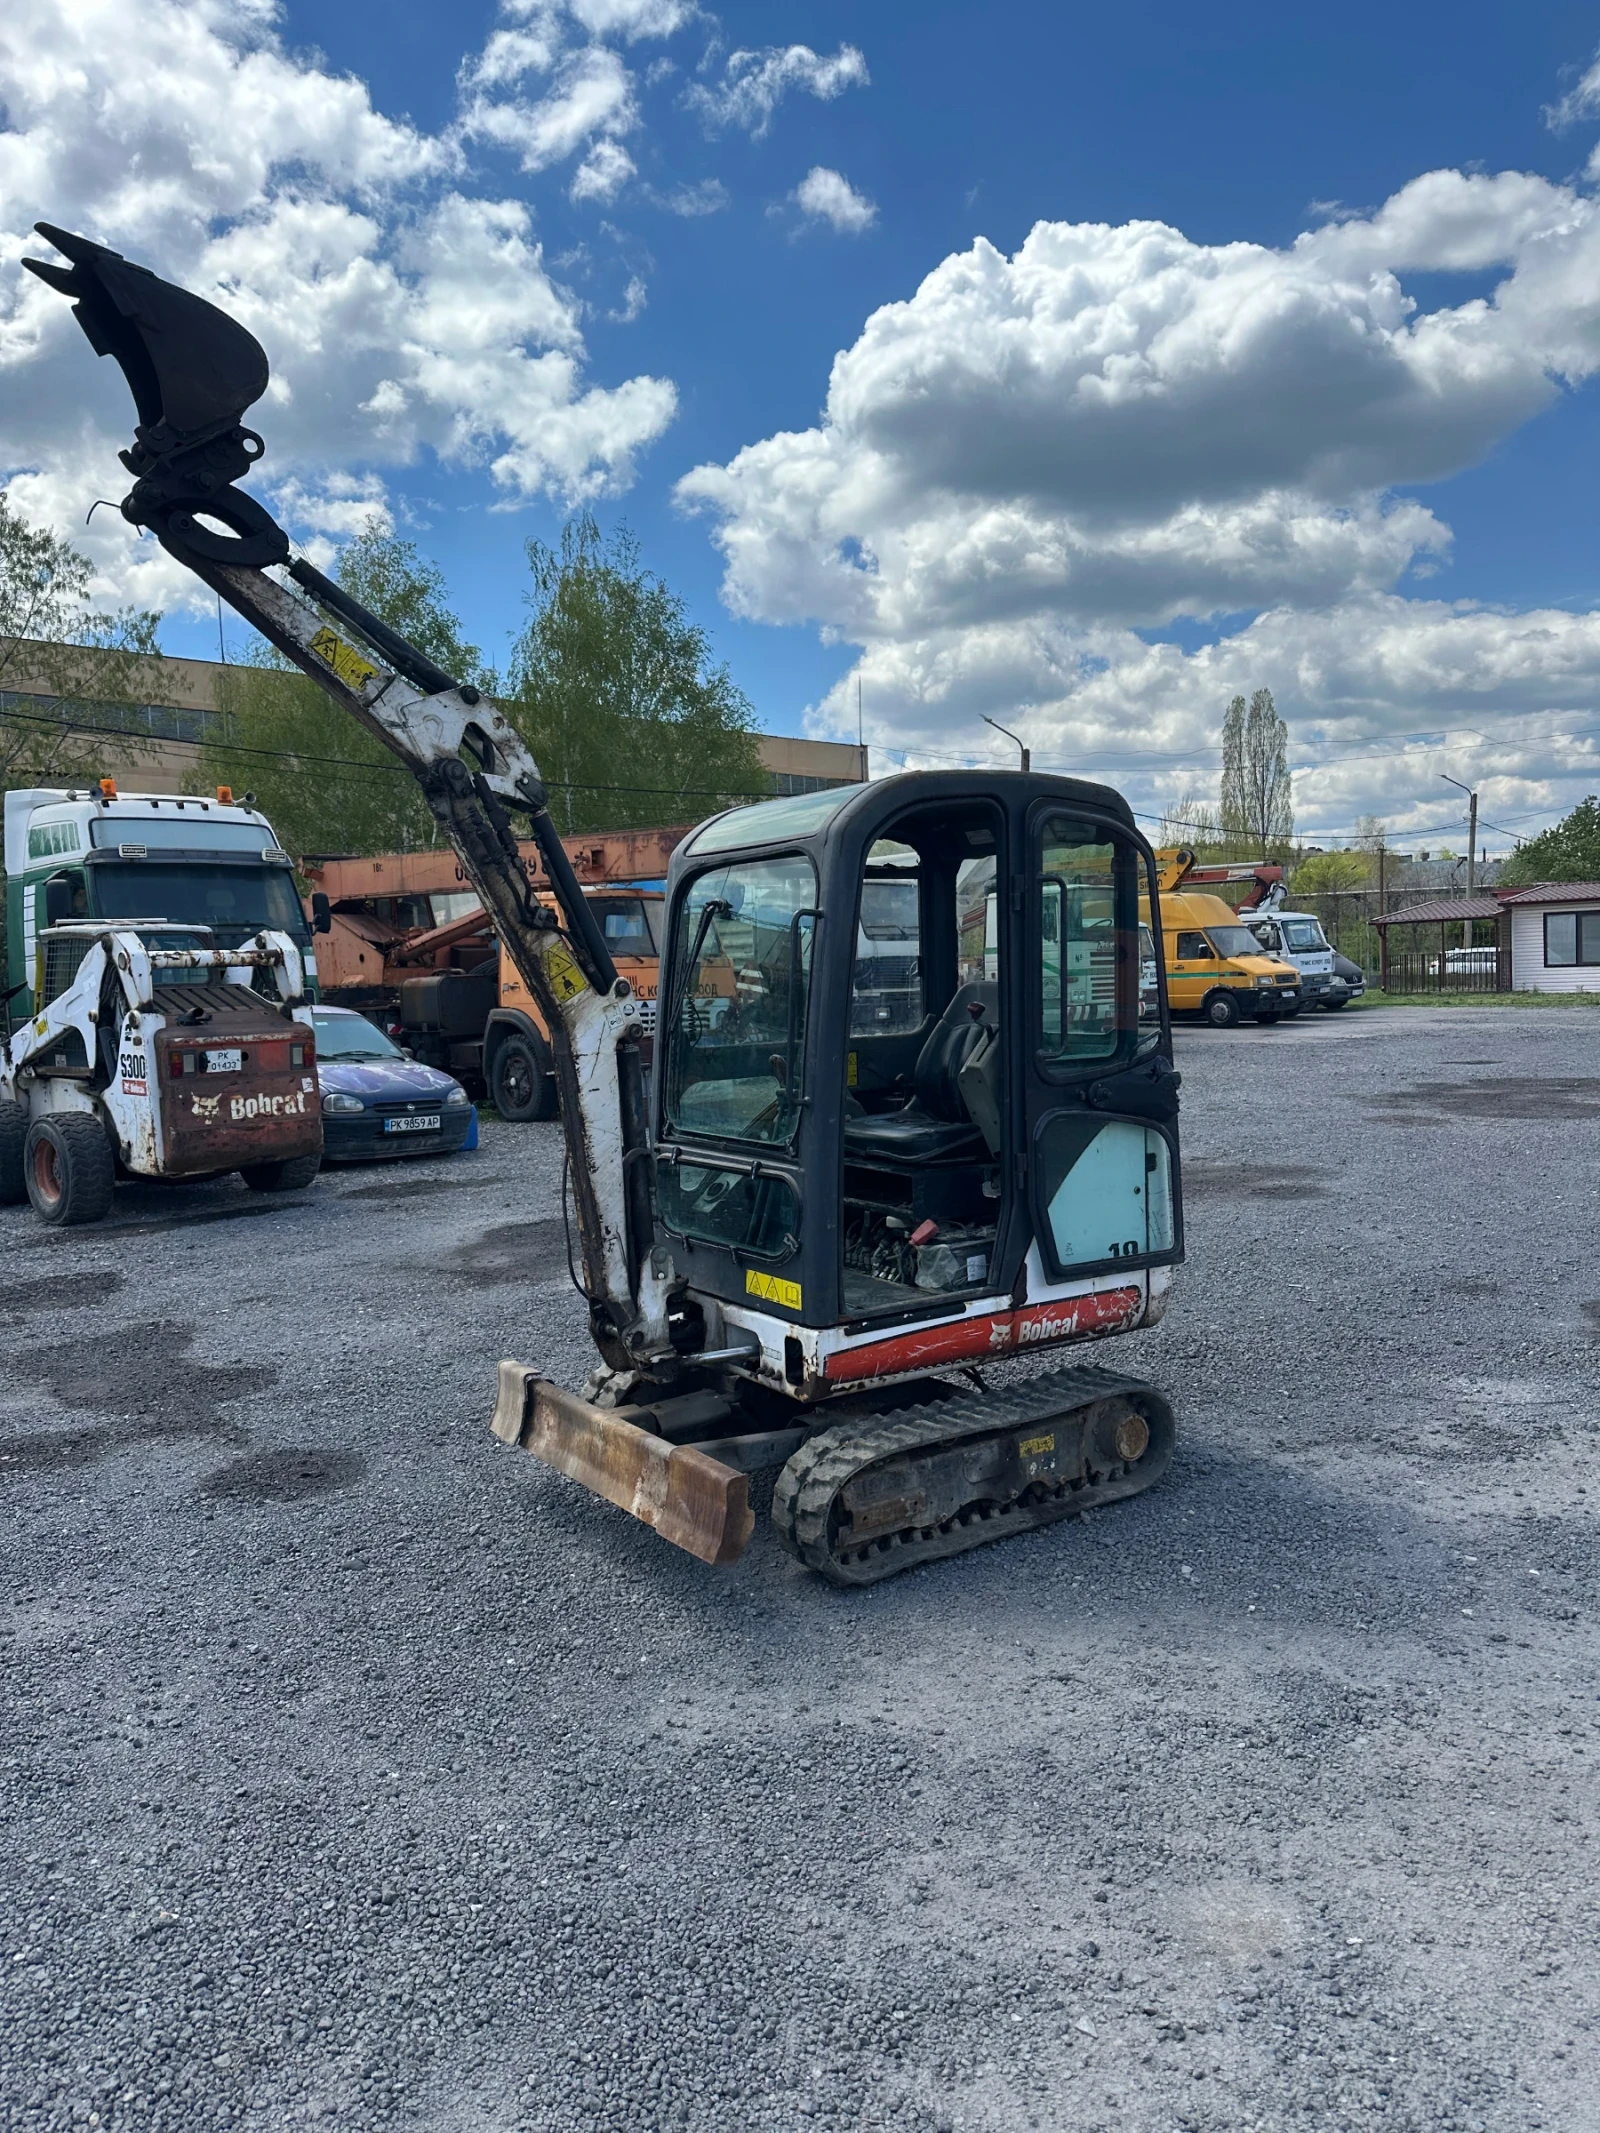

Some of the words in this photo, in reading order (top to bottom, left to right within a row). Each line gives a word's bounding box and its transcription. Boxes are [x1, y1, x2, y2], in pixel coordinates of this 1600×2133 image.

[120, 1054, 146, 1079] S300
[230, 1090, 305, 1120] Bobcat
[390, 1120, 402, 1130] PK
[427, 1117, 439, 1127] AP
[1017, 1312, 1078, 1343] Bobcat
